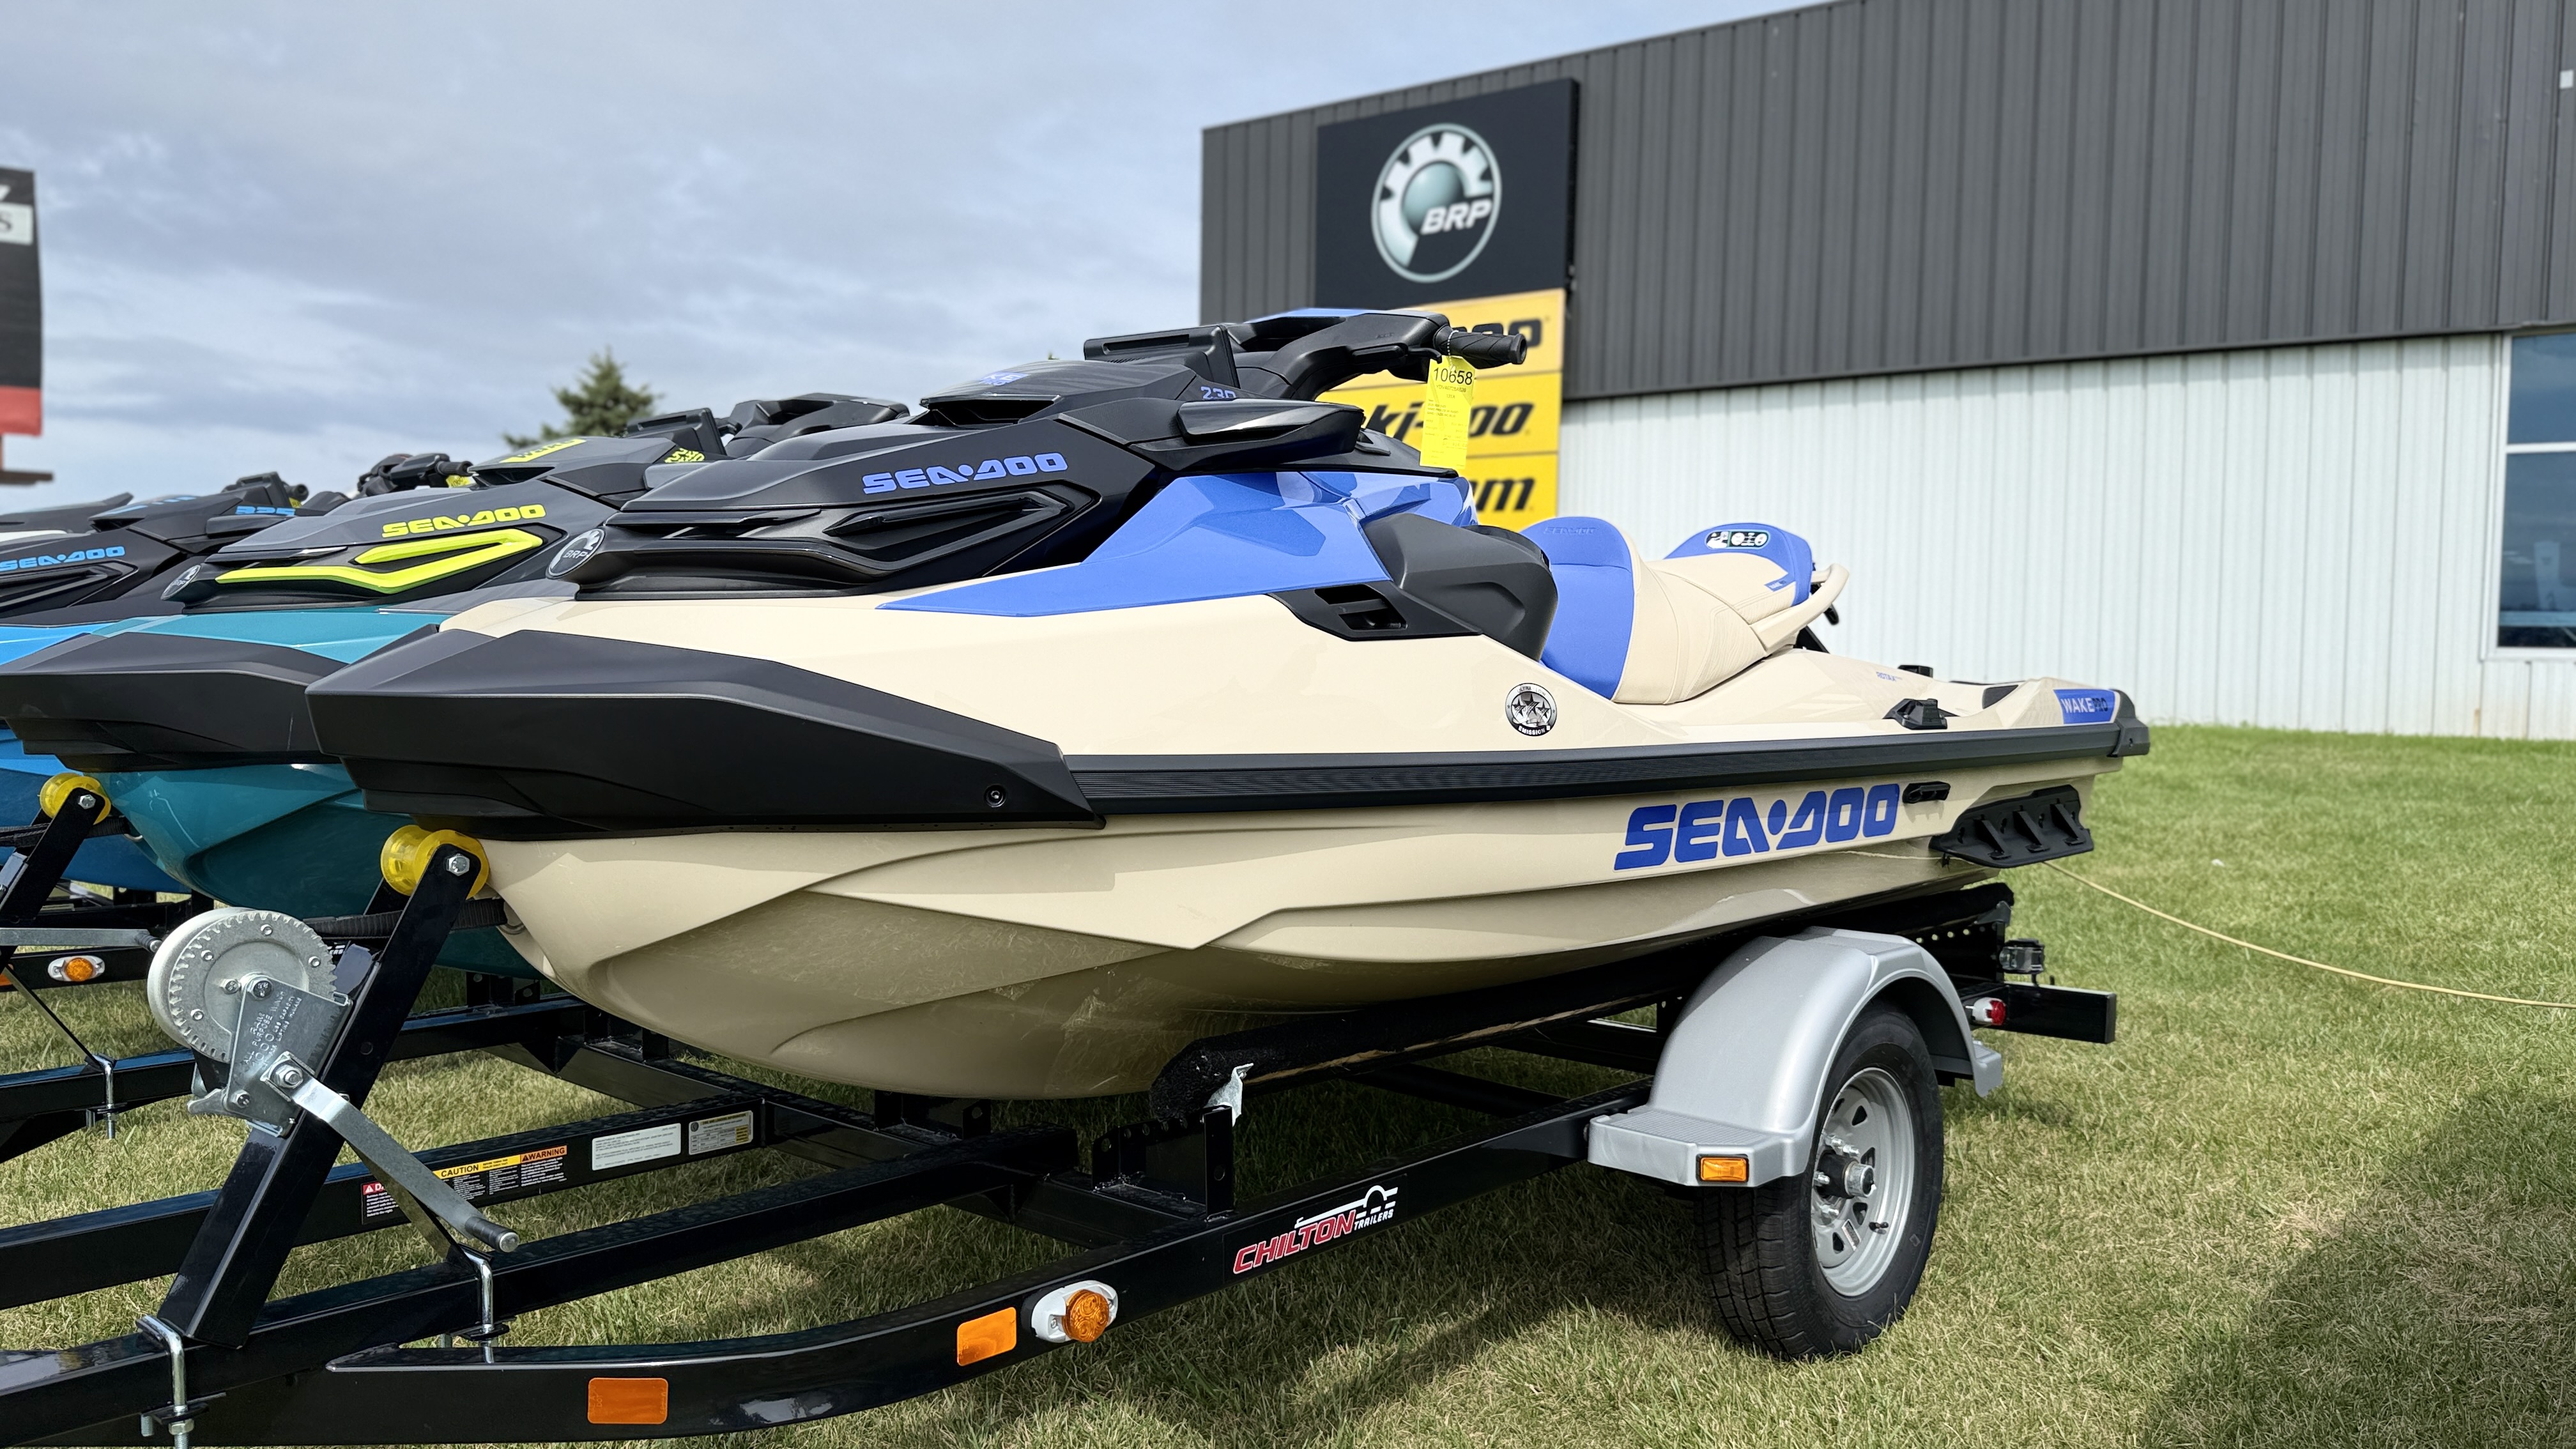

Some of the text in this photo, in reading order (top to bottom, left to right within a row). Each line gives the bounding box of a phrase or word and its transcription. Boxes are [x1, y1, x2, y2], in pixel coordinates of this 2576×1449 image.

[1420, 199, 1492, 236] BRP
[1433, 367, 1473, 386] 10658
[1200, 386, 1237, 400] 230
[563, 549, 588, 559] BRP
[1518, 725, 1545, 735] EMISSION
[528, 1147, 565, 1160] WARNING
[441, 1163, 479, 1177] CAUTION
[1354, 1209, 1394, 1231] TRAILERS
[1232, 1209, 1356, 1274] CHILTON
